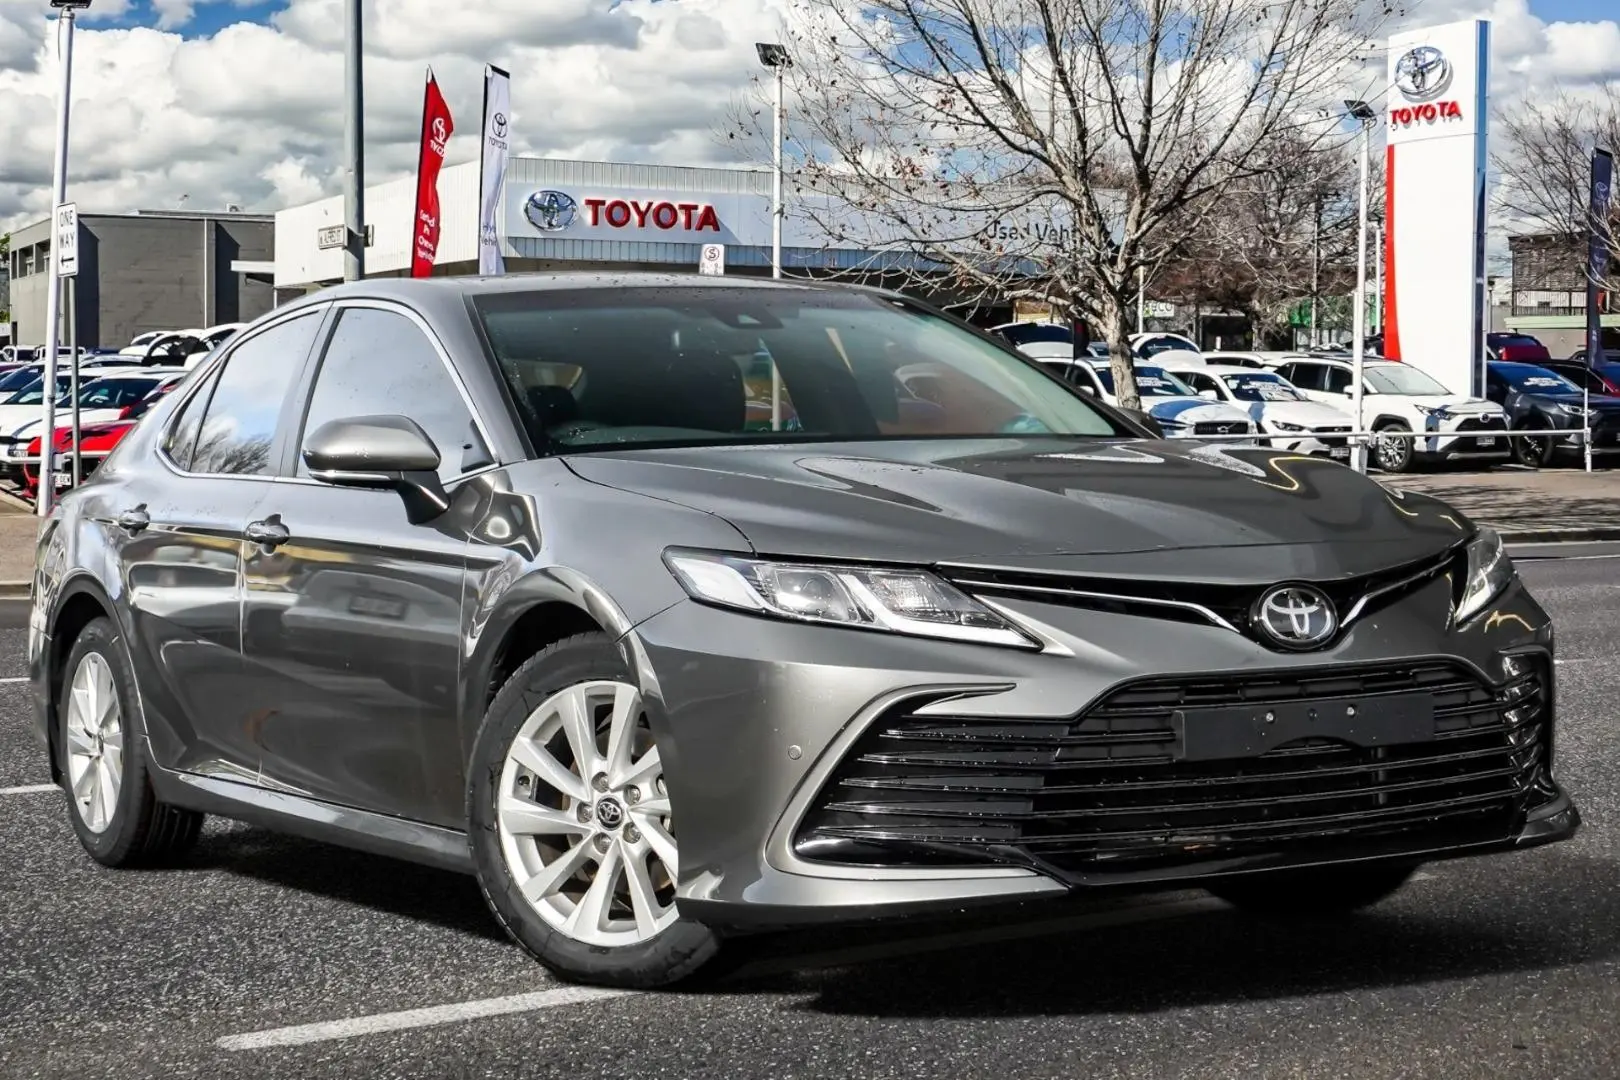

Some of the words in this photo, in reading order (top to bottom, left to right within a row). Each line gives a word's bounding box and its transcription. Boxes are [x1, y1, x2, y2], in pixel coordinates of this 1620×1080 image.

[1389, 101, 1463, 125] TOYOTA
[60, 209, 74, 228] ONE
[584, 198, 721, 231] TOYOTA
[60, 232, 75, 249] WAY
